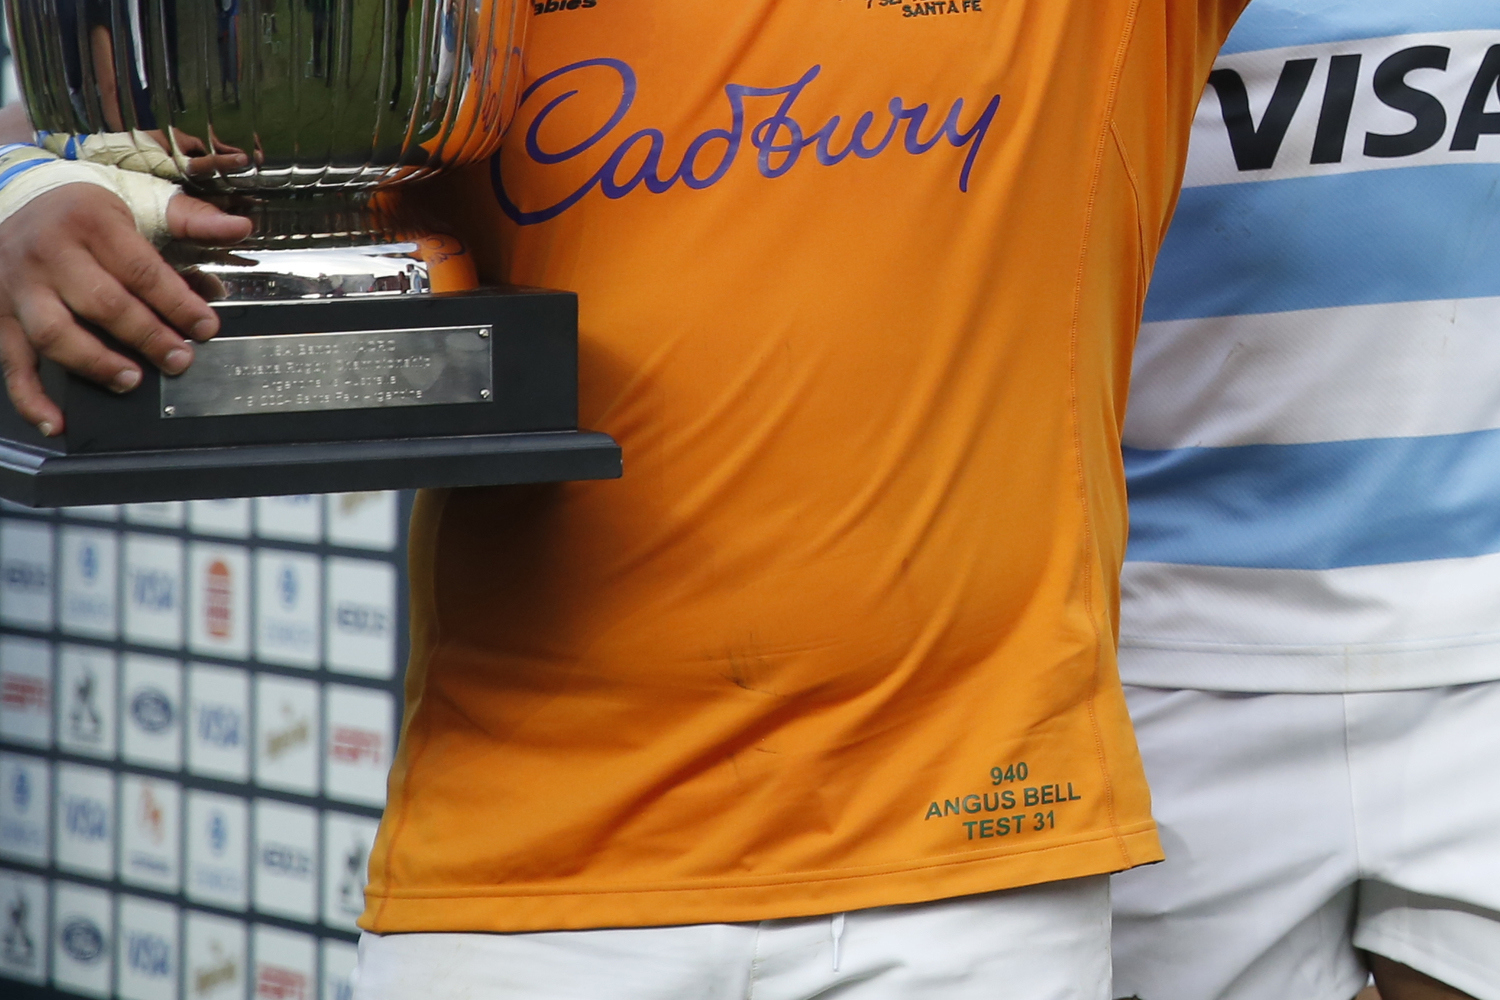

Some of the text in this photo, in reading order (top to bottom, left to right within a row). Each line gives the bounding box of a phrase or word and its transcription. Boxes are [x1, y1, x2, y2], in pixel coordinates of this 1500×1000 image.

[902, 0, 960, 18] SANTA
[491, 58, 1001, 227] Cadbury
[990, 762, 1029, 786] 940
[925, 782, 1081, 821] ANGUS BELL
[962, 810, 1056, 840] TEST 31
